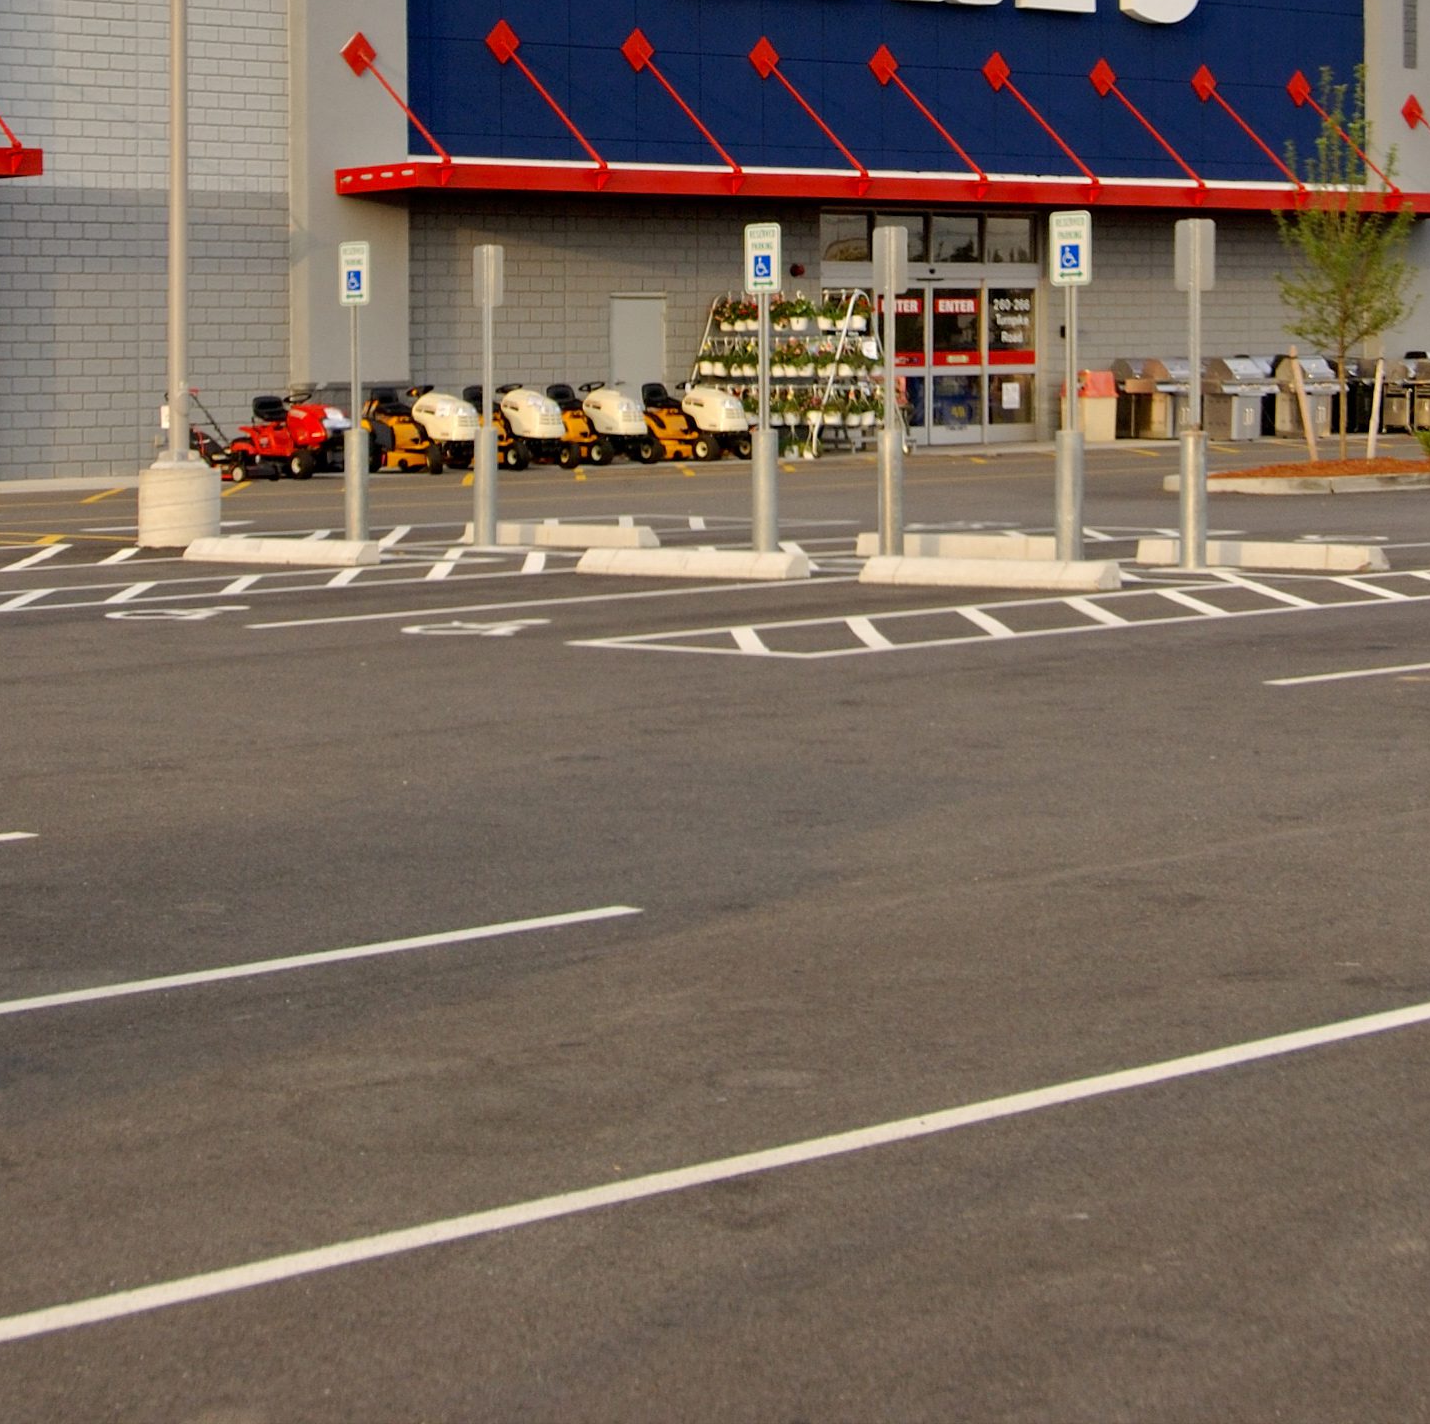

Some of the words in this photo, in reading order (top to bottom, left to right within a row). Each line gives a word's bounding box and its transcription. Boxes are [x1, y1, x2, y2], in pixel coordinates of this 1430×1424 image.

[938, 299, 975, 313] ENTER
[995, 313, 1030, 326] Turnpike
[1001, 330, 1024, 343] Road
